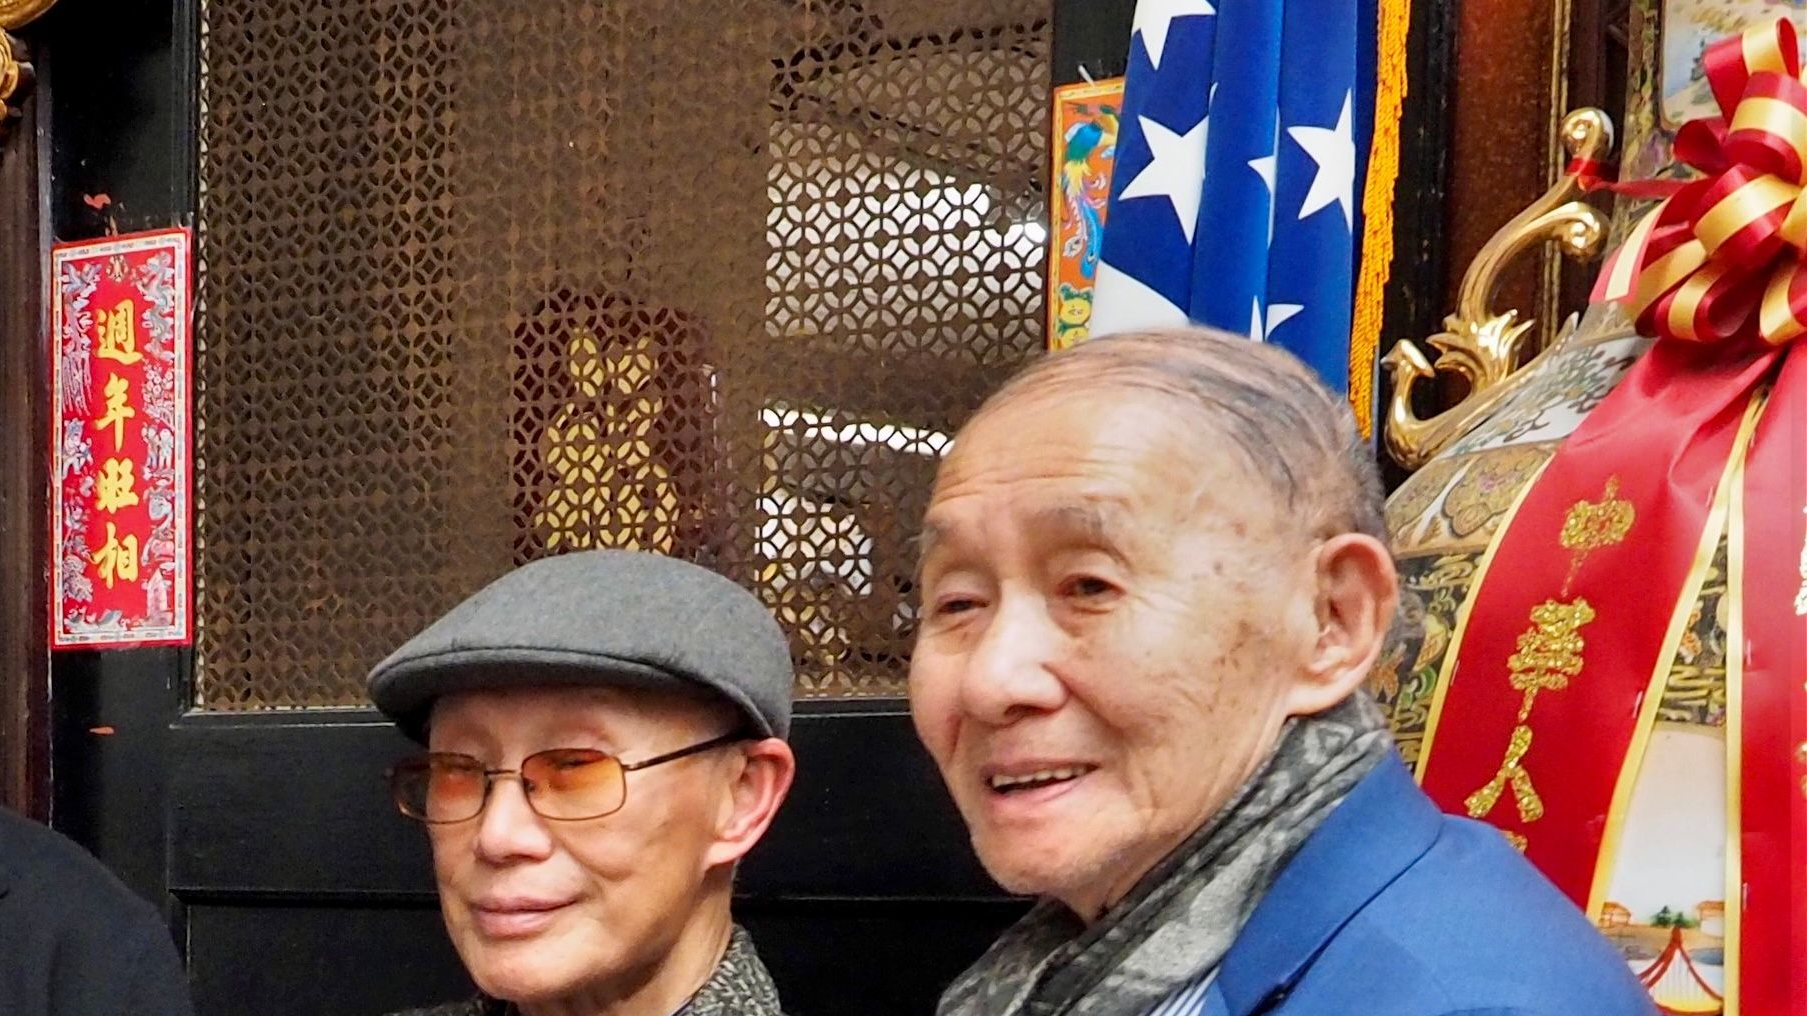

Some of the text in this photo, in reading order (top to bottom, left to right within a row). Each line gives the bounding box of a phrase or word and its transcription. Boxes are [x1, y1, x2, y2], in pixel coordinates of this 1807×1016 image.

[93, 298, 143, 590] 週年旺相
[1465, 474, 1636, 853] 中華人
